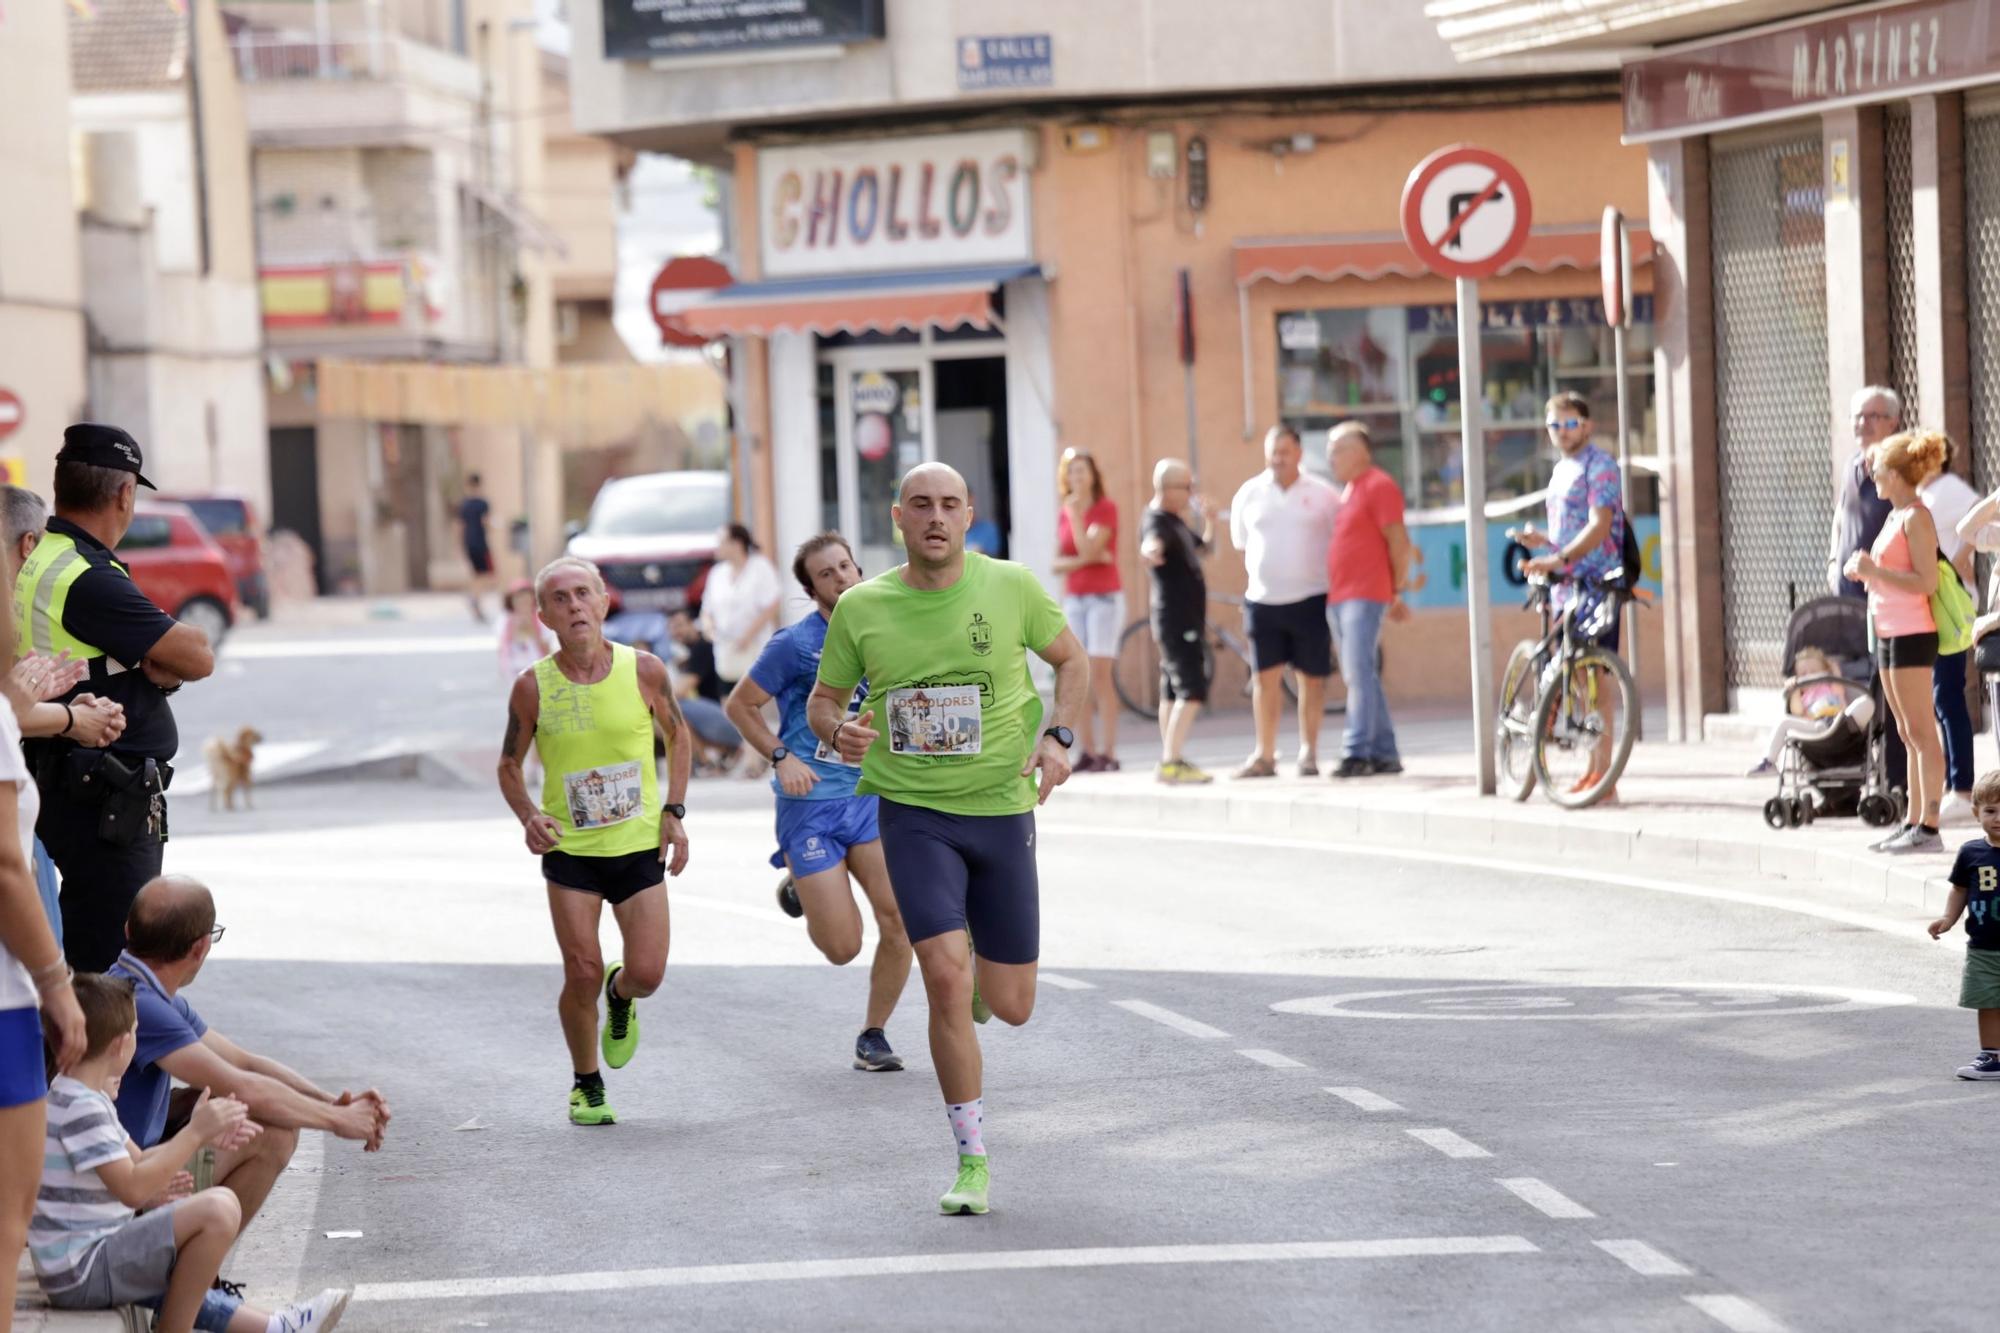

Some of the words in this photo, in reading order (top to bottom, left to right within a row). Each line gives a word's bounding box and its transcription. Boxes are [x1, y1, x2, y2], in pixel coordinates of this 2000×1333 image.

[1791, 14, 1940, 100] MARTÍNEZ
[771, 153, 1018, 251] CHOLLOS
[892, 698, 914, 709] LOS
[911, 713, 960, 735] 130
